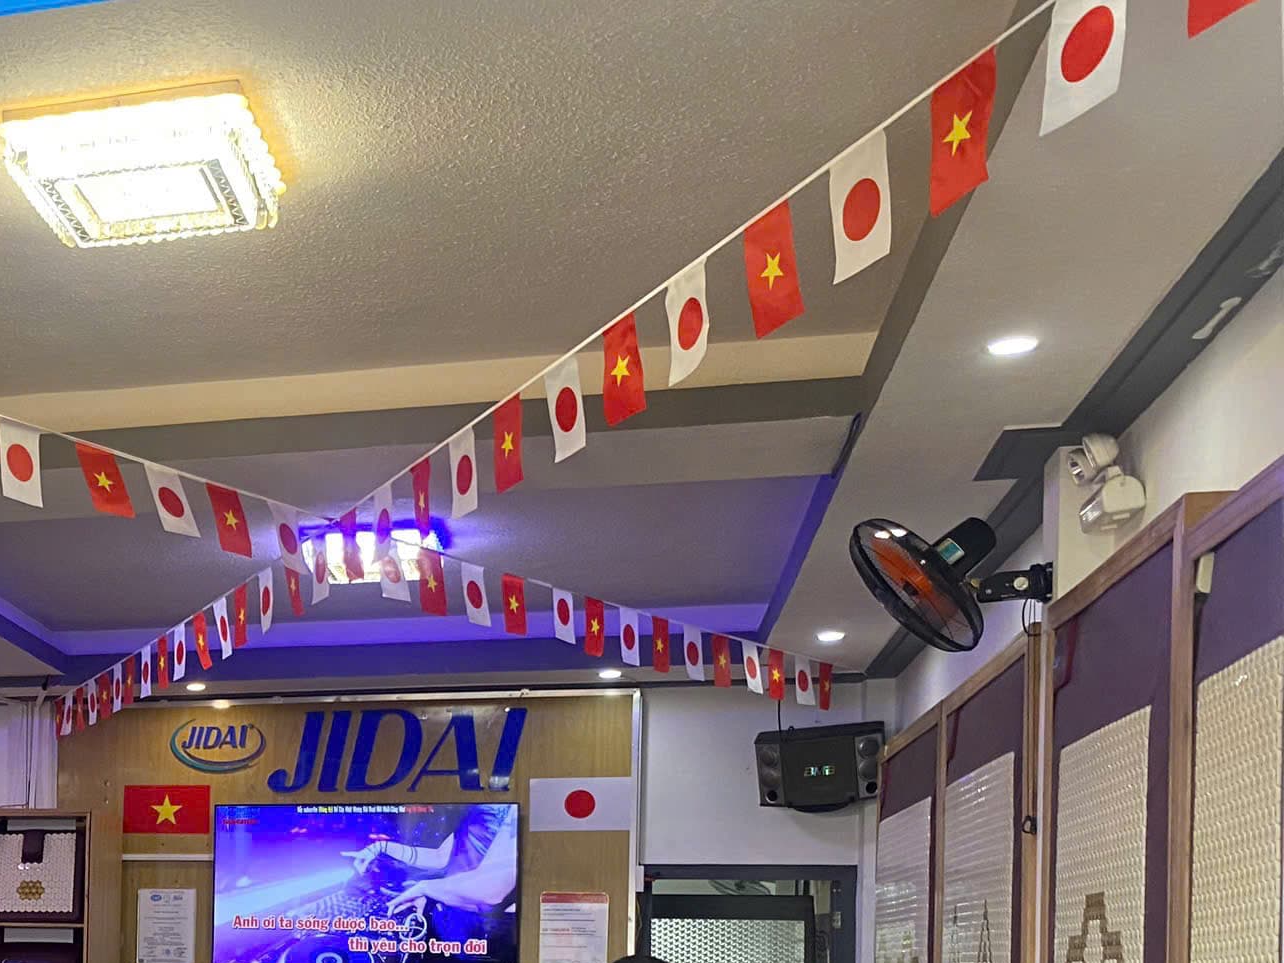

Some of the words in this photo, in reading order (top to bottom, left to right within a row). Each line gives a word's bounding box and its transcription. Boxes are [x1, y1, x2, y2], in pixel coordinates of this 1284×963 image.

[181, 725, 249, 750] JIDAI
[267, 708, 528, 793] JIDAI
[233, 914, 258, 930] Anh
[279, 916, 293, 930] ta
[297, 913, 329, 932] sống
[333, 916, 366, 934] được
[370, 916, 409, 932] bao...
[371, 939, 396, 954] yêu
[400, 938, 427, 953] cho
[430, 938, 461, 956] trọn
[464, 938, 487, 954] đời
